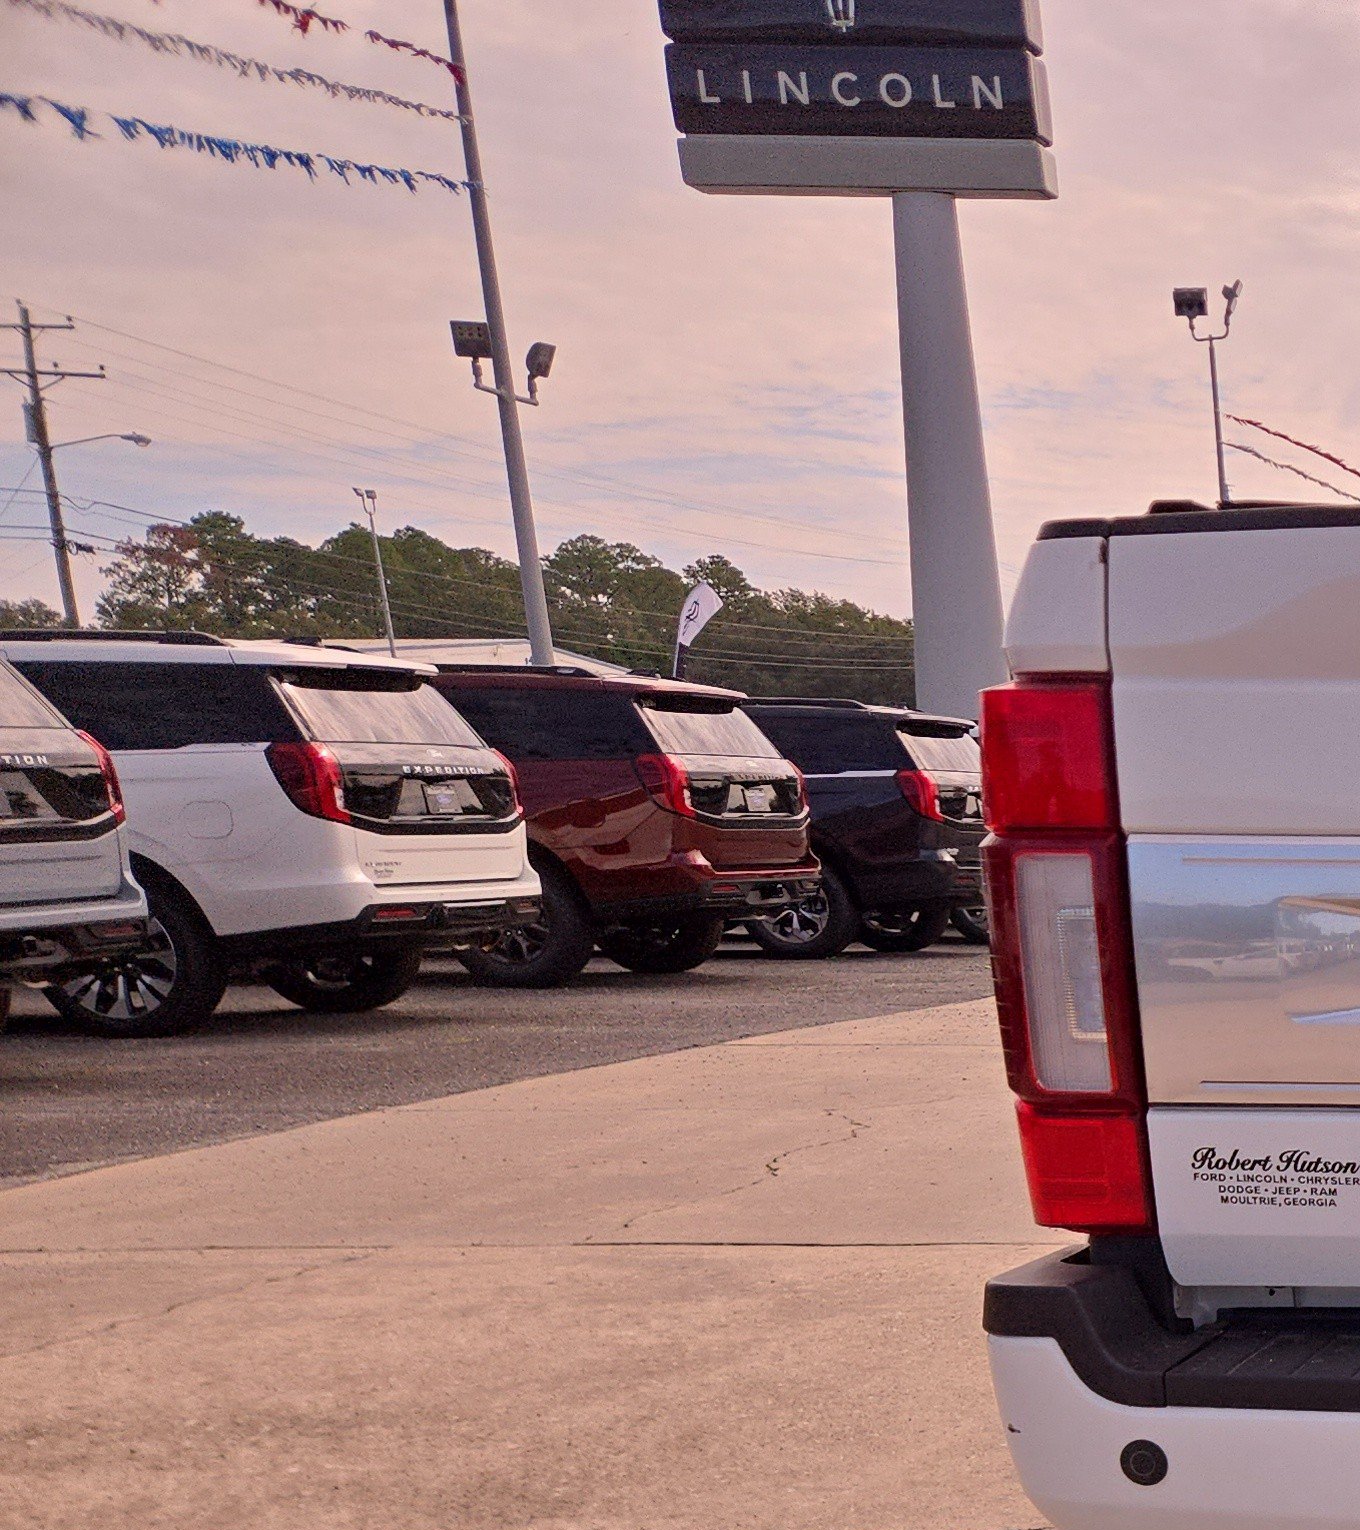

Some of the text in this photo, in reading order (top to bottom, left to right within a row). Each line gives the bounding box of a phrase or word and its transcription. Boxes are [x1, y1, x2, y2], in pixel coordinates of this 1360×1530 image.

[696, 69, 1004, 110] LINCOLN
[402, 765, 484, 775] EXPEDITION
[1191, 1147, 1360, 1174] Robert Hutson
[1193, 1172, 1360, 1186] FORD LINCOLN CHRYSLER
[1218, 1185, 1338, 1196] DODGE JEEP RAM
[1283, 1197, 1337, 1207] GEORGIA
